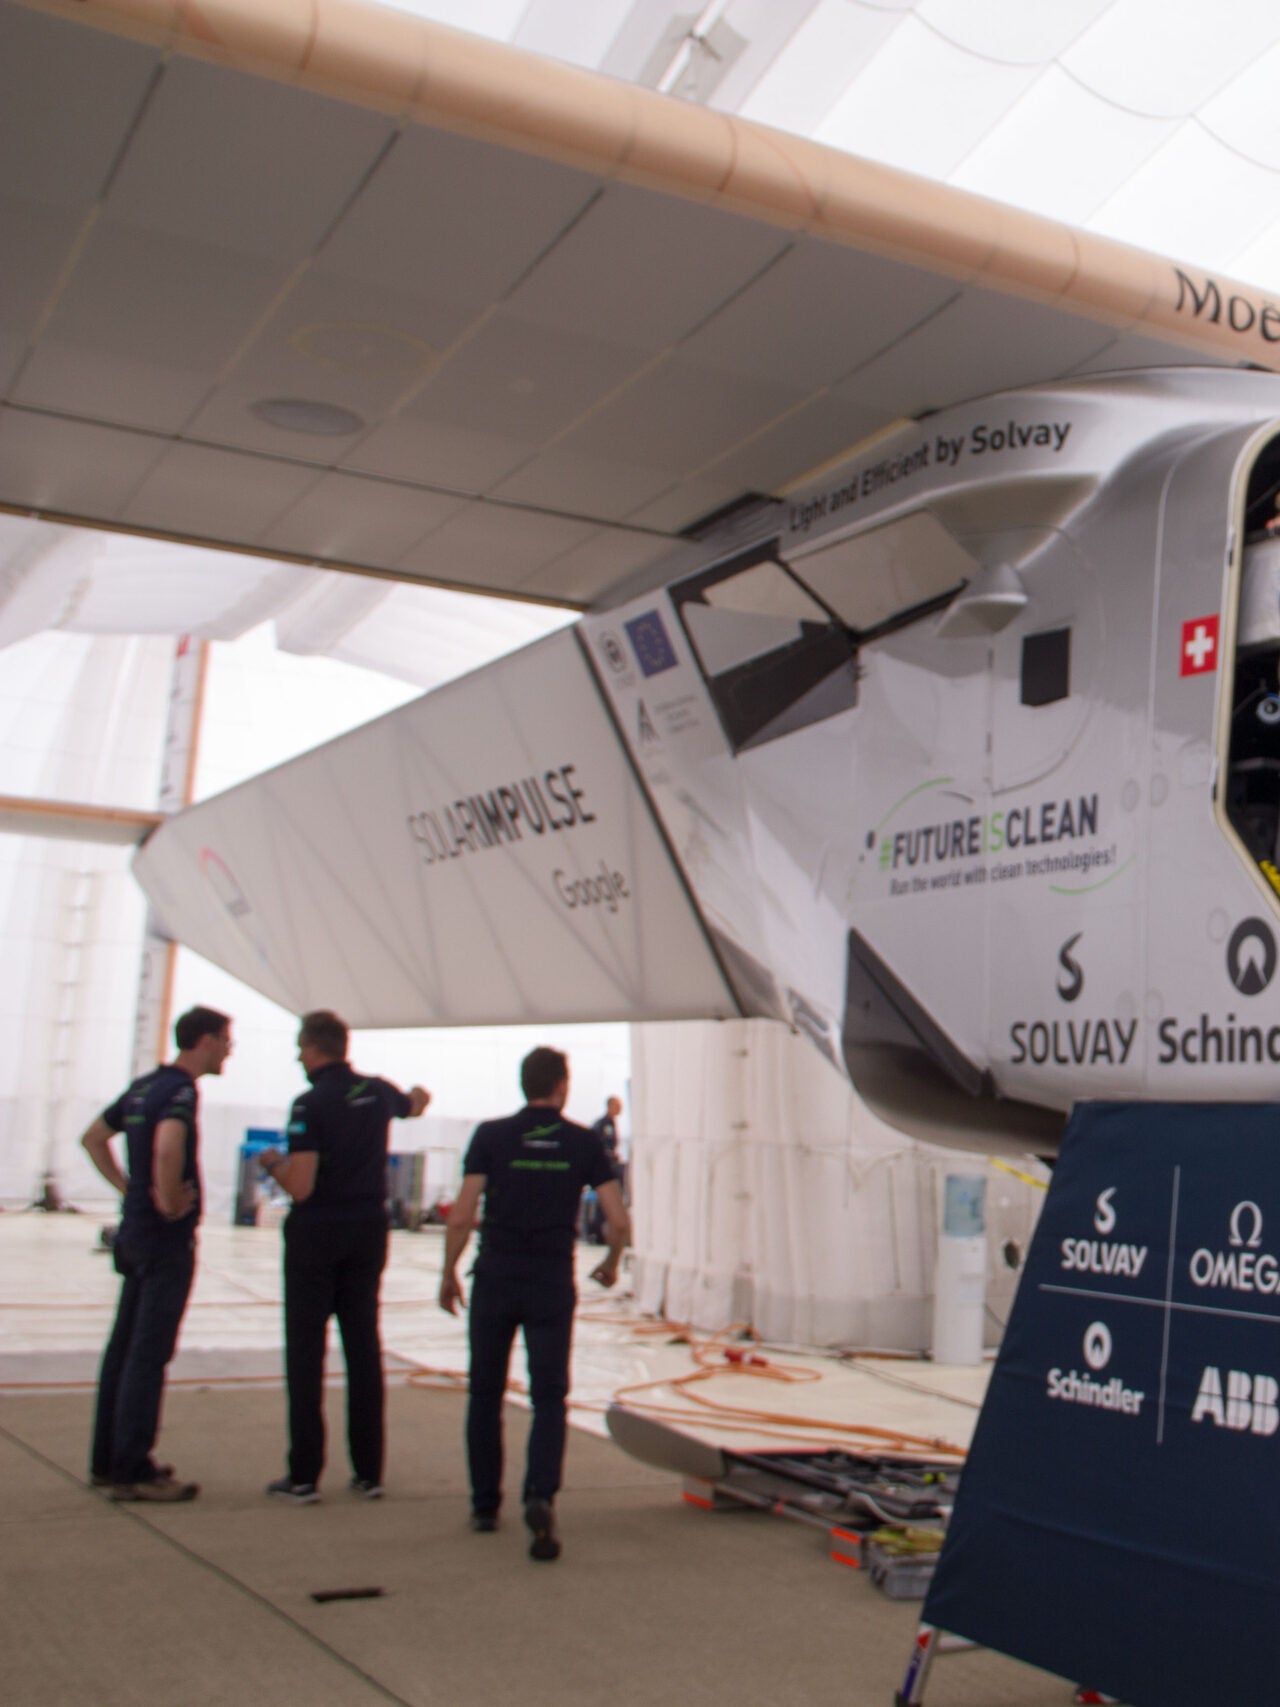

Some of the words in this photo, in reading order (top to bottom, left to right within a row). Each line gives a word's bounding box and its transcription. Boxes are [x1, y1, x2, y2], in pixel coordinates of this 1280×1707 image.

[830, 478, 858, 512] and
[861, 444, 929, 496] Efficient
[934, 435, 965, 466] by
[968, 421, 1071, 455] Solvay
[552, 858, 632, 914] Google
[964, 864, 988, 884] with
[991, 861, 1022, 882] clean
[1009, 1017, 1139, 1065] SOLVAY
[1060, 1236, 1149, 1279] SOLVAY
[1046, 1366, 1145, 1417] Schindler
[1190, 1364, 1280, 1438] ABB
